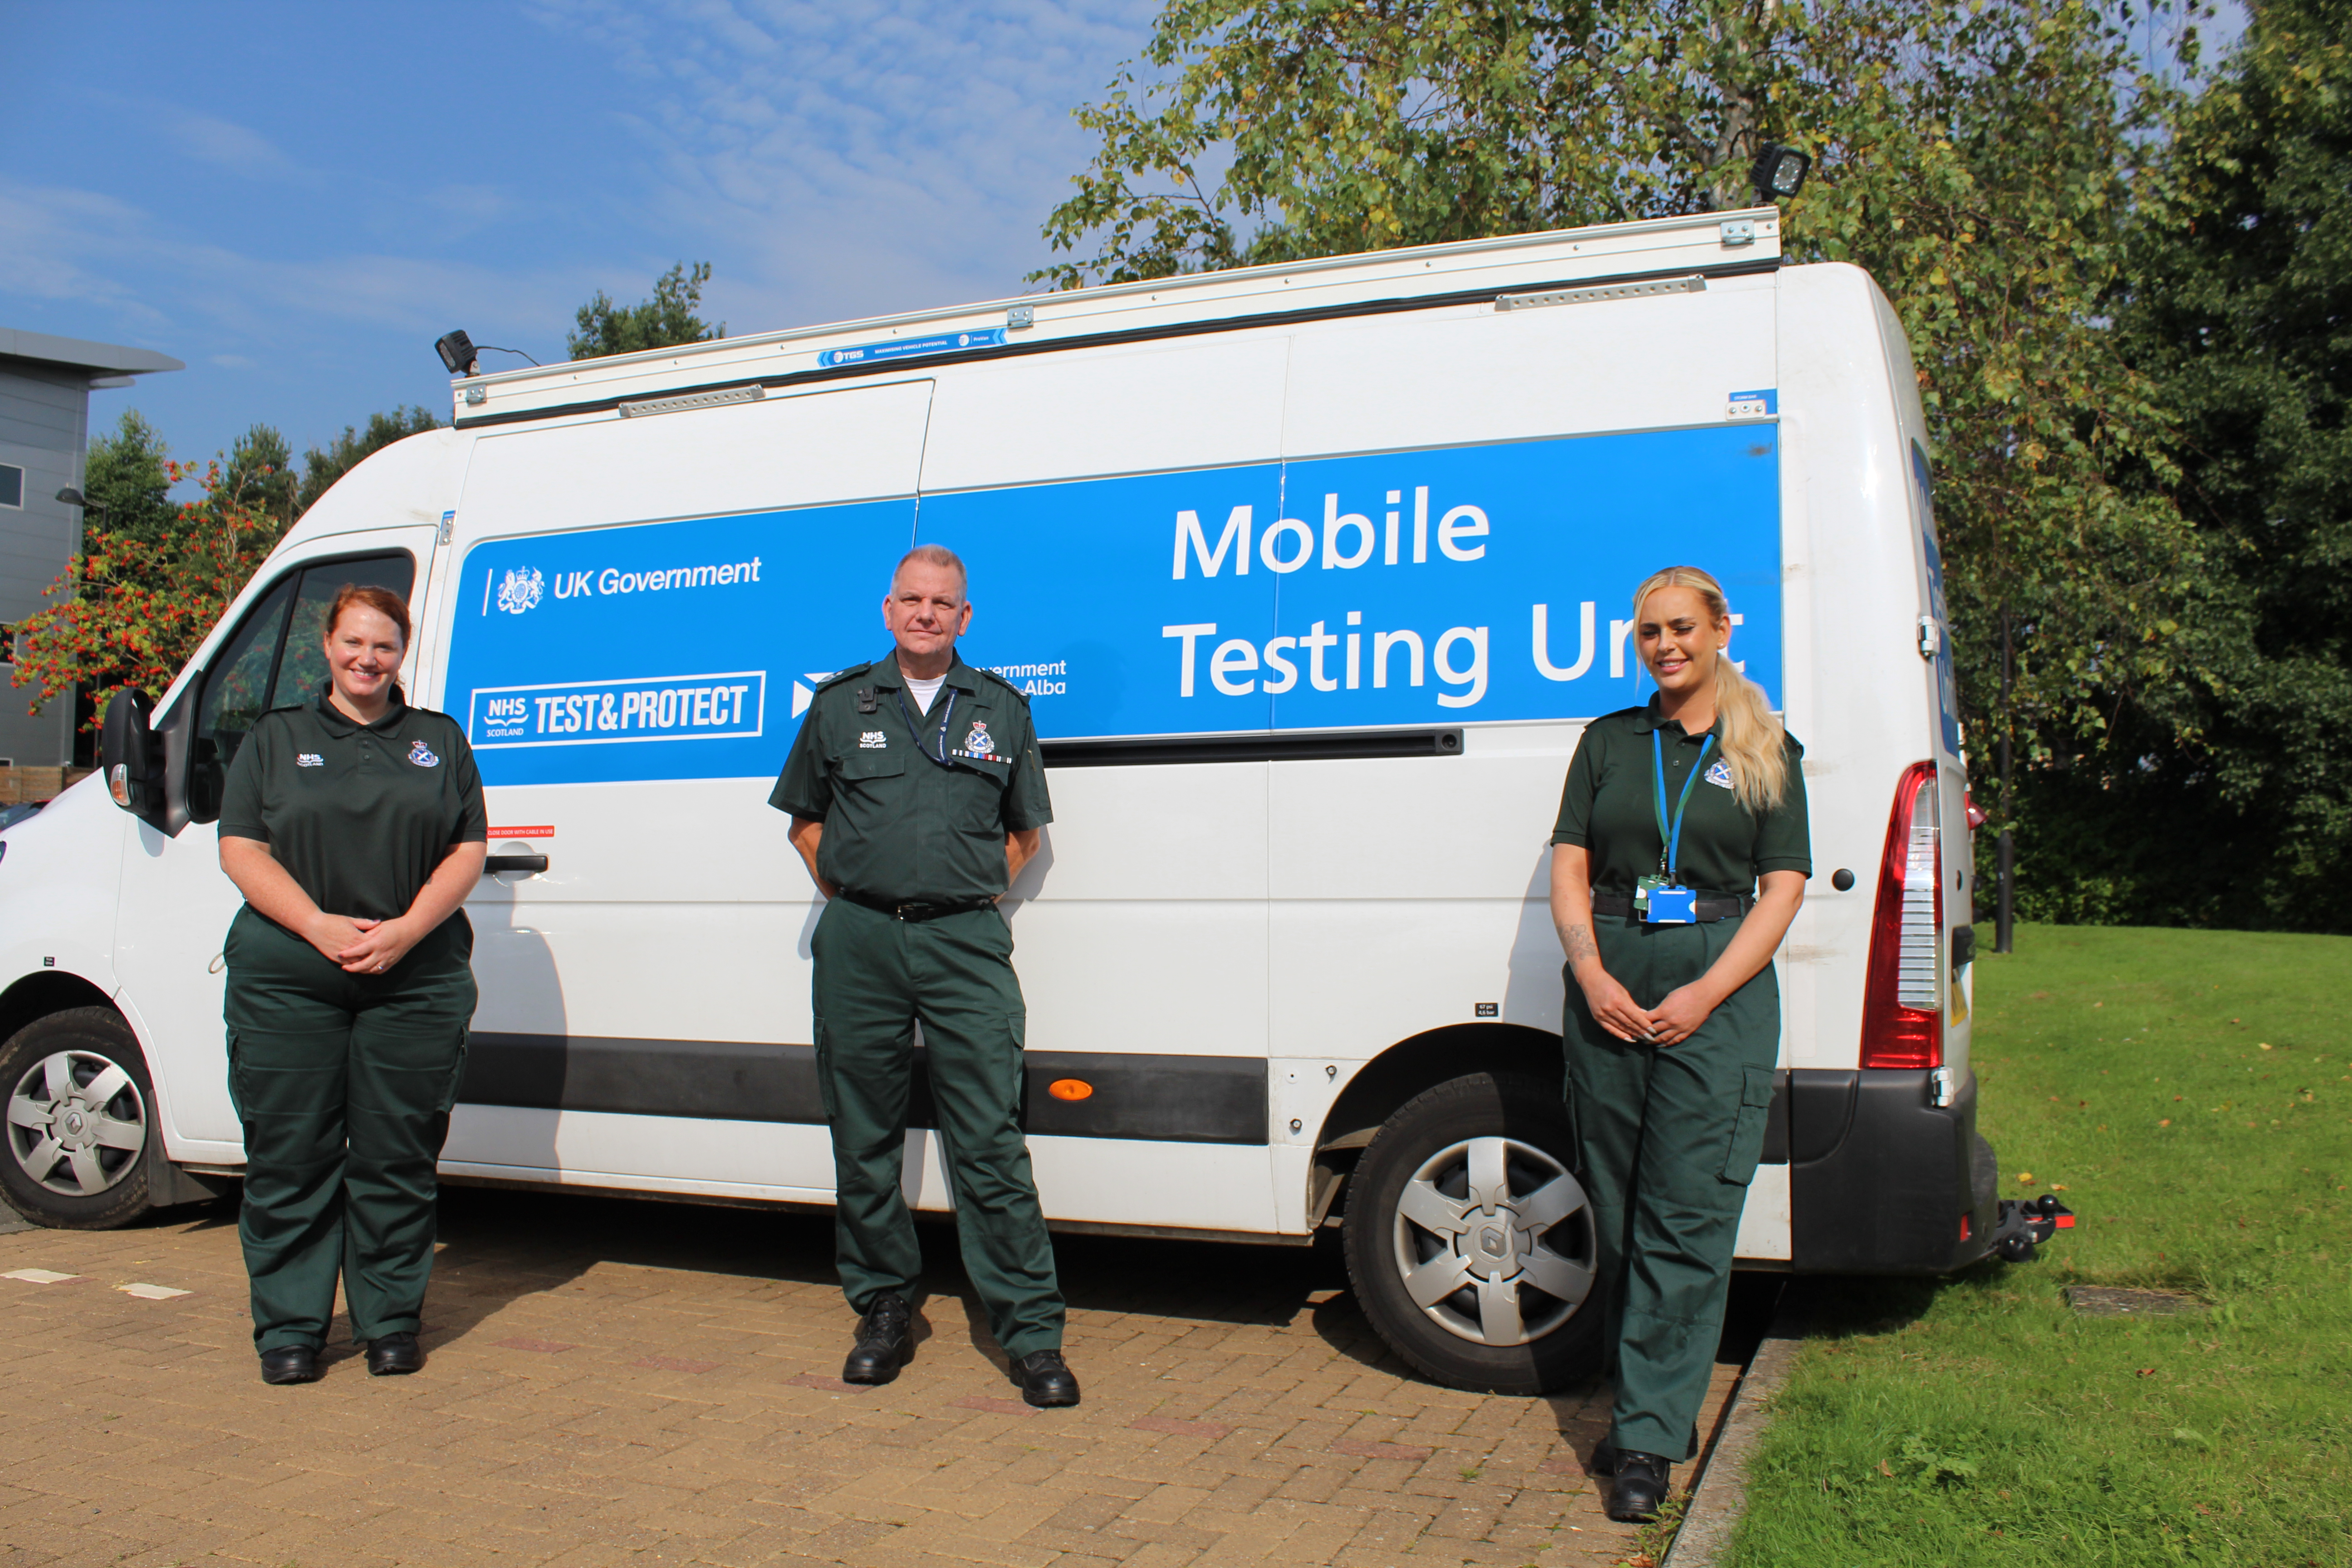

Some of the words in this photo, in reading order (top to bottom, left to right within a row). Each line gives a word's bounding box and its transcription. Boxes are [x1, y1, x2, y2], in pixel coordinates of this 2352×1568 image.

[922, 340, 947, 348] POTENTIAL
[843, 350, 864, 360] TGS
[1172, 485, 1490, 580] Mobile
[554, 570, 594, 599] UK
[598, 557, 762, 595] Government
[1162, 611, 1489, 708] Testing
[974, 660, 1066, 678] ernment
[1021, 679, 1066, 696] Alba
[489, 697, 526, 716] NHS
[534, 685, 748, 733] TEST&PROTECT
[486, 728, 524, 737] SCOTLAND
[862, 730, 884, 740] NHS
